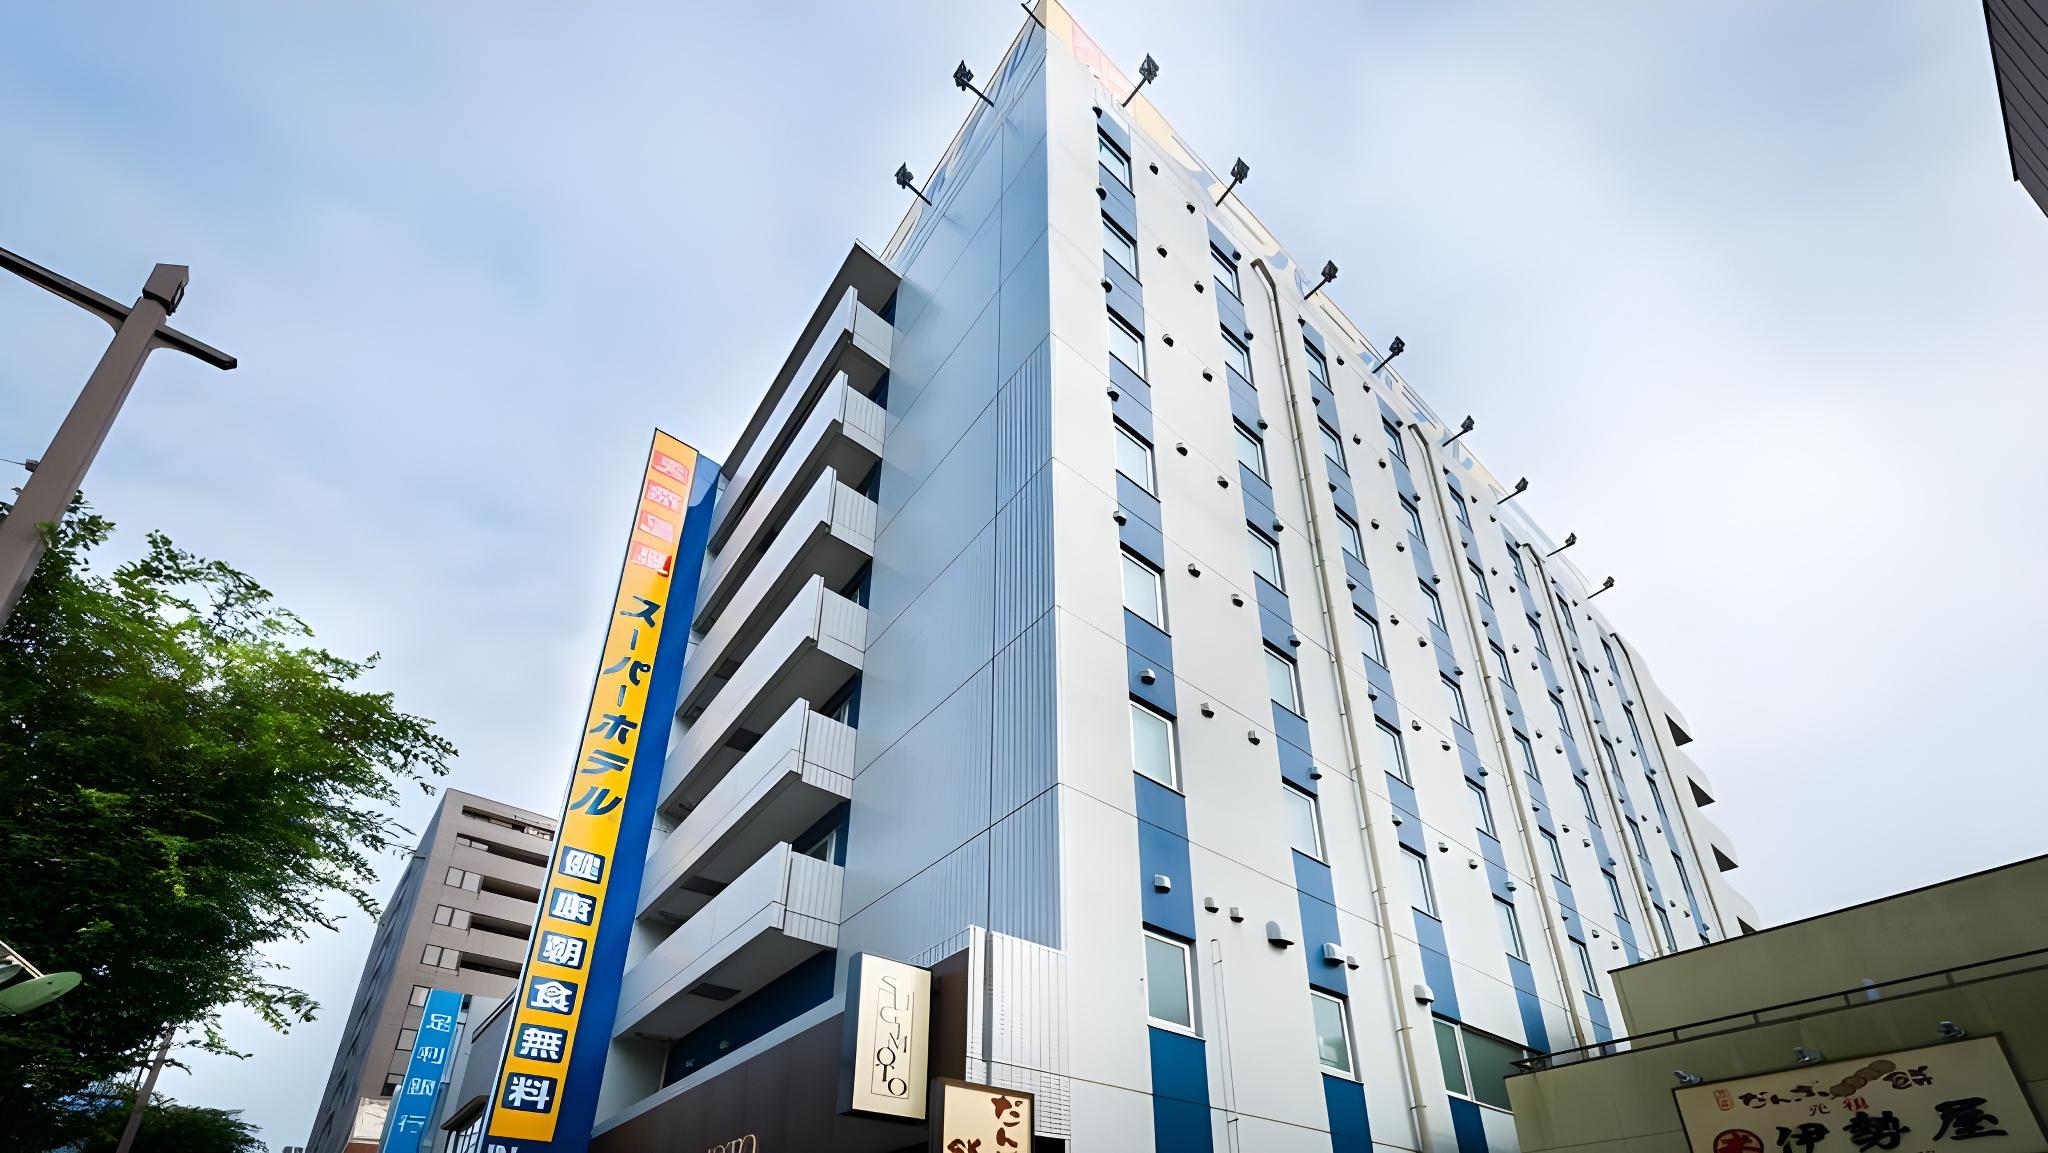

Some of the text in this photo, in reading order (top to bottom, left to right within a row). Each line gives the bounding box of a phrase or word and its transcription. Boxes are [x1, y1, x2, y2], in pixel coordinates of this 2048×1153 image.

[569, 594, 661, 816] スーパーホテル
